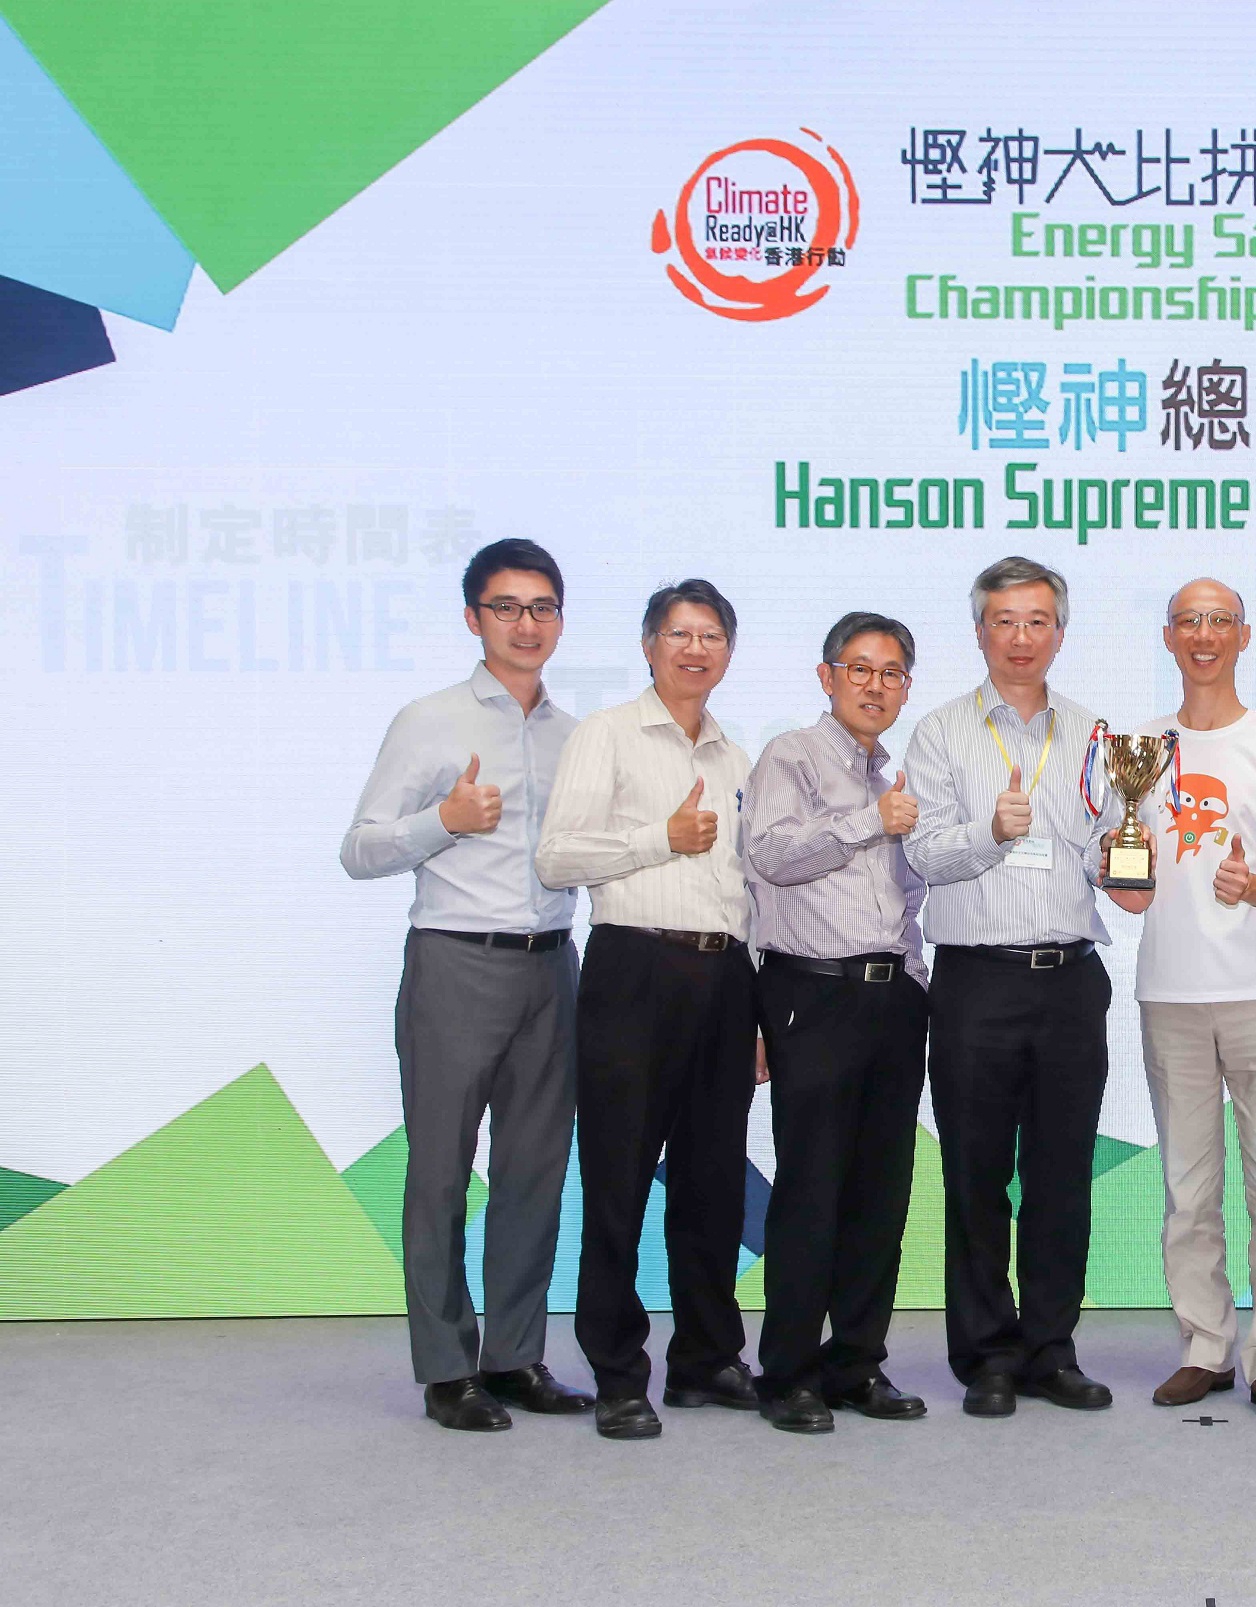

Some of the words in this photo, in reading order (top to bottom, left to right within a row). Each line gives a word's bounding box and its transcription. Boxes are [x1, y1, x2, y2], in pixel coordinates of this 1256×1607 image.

[706, 176, 808, 214] Climate
[706, 215, 806, 246] Ready@HK
[1012, 212, 1193, 268] Energy
[764, 246, 846, 267] 香港行動
[775, 461, 984, 529] Hanson
[1004, 462, 1250, 545] Supreme
